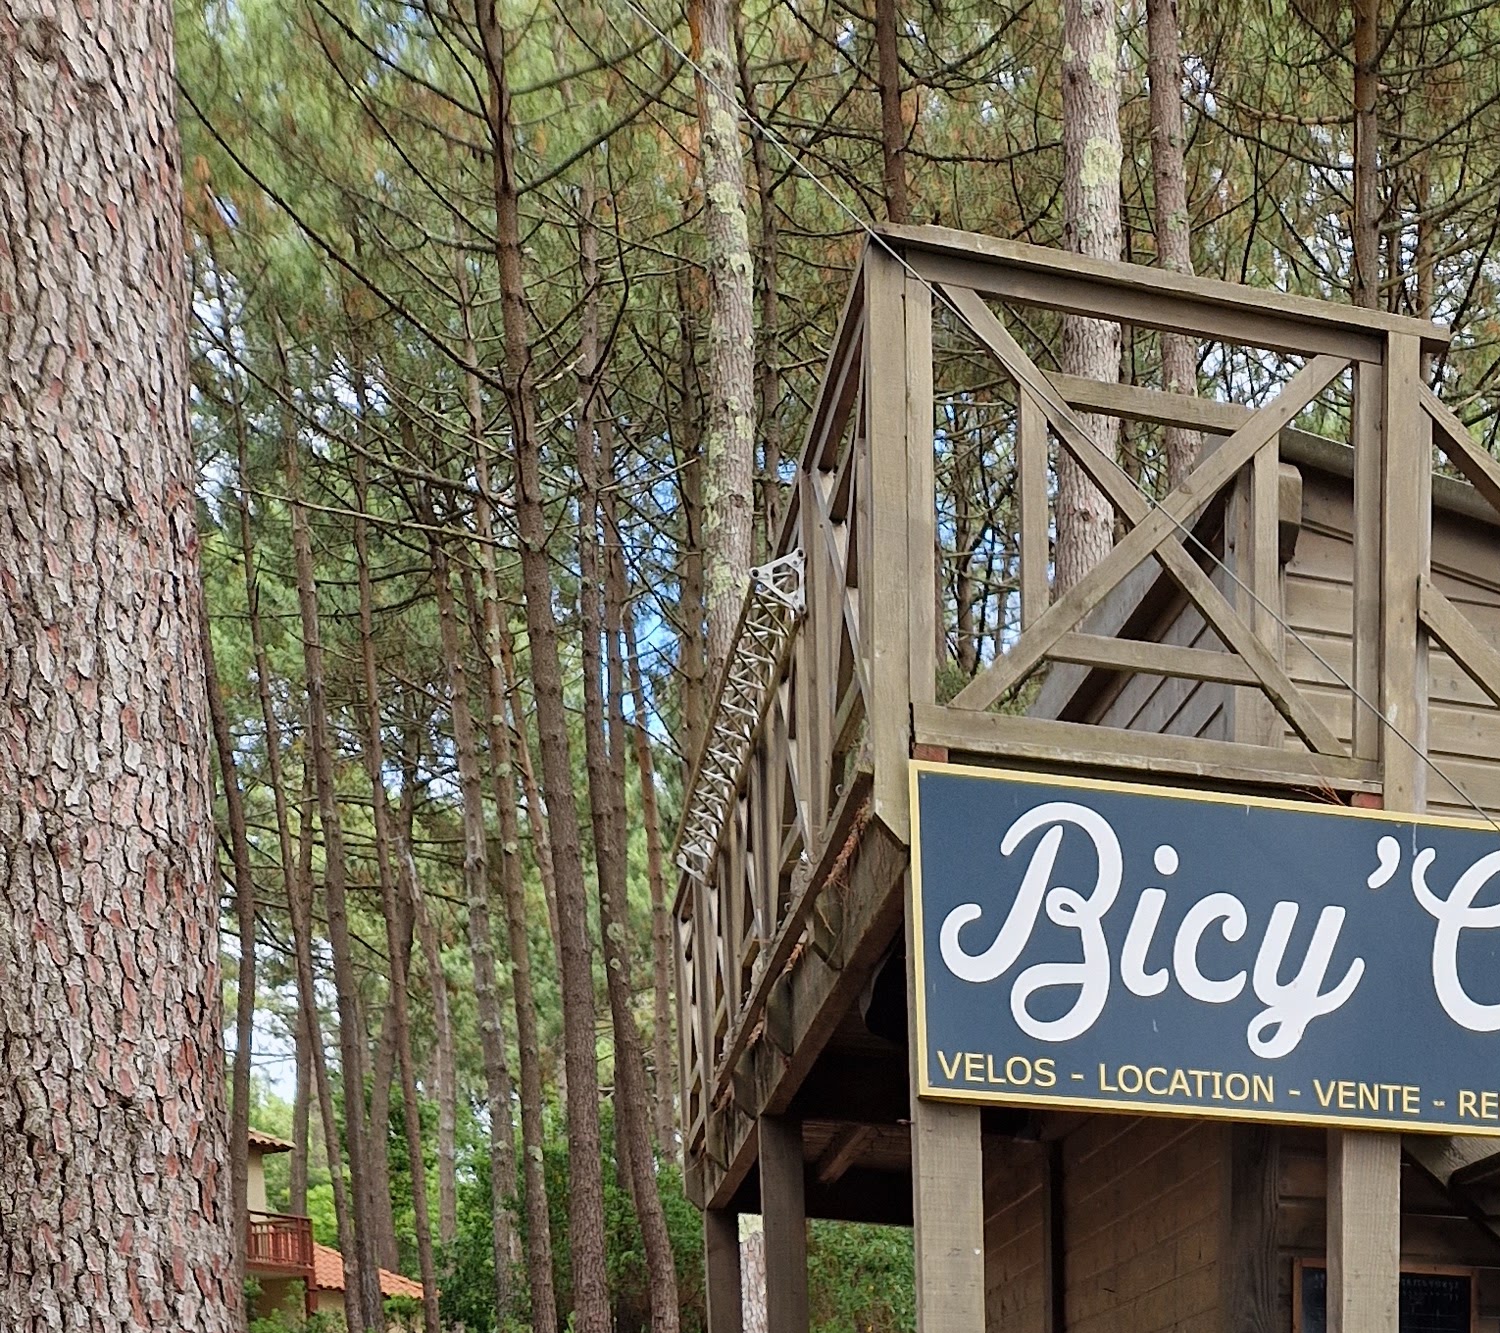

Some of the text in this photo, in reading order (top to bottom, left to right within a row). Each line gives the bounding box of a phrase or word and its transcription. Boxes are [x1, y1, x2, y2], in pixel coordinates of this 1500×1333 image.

[937, 1051, 1056, 1087] VELOS
[1099, 1063, 1274, 1103] LOCATION
[1313, 1079, 1420, 1114] VENTE
